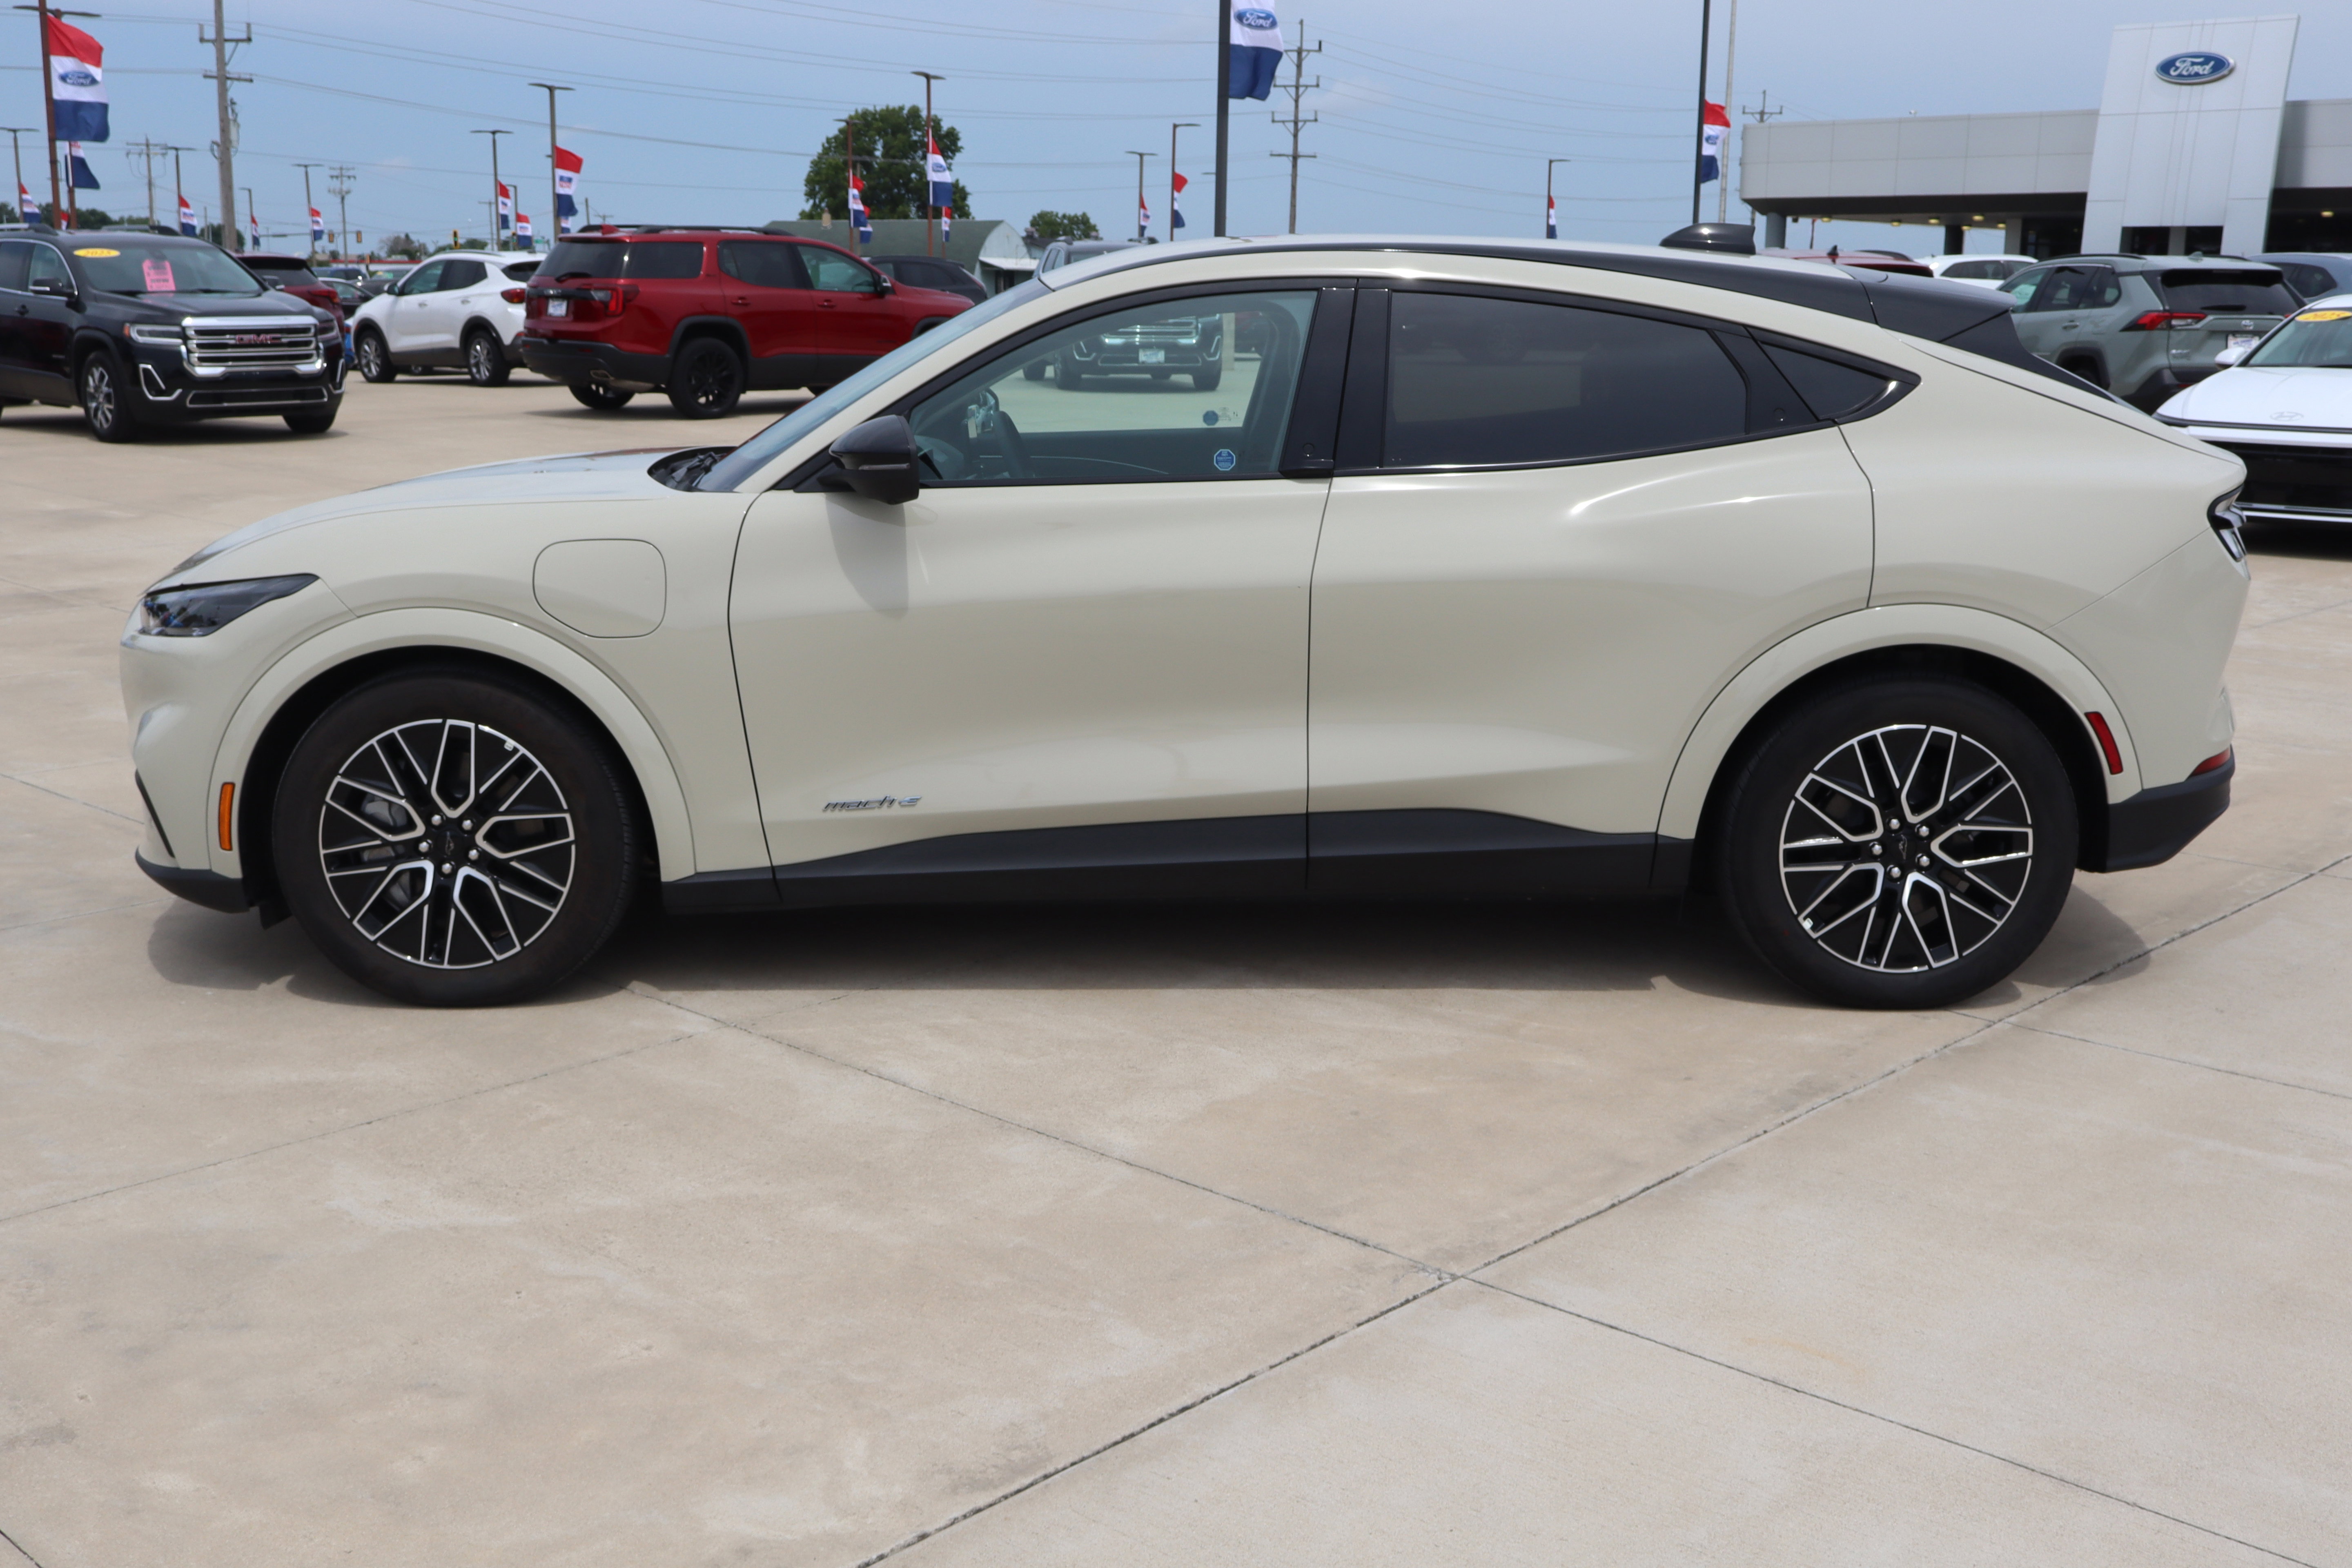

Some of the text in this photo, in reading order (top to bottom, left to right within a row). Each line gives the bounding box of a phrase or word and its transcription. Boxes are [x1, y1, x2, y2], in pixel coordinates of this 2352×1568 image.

[1243, 10, 1273, 27] Ford
[2169, 57, 2215, 76] Ford
[236, 334, 281, 344] GMC
